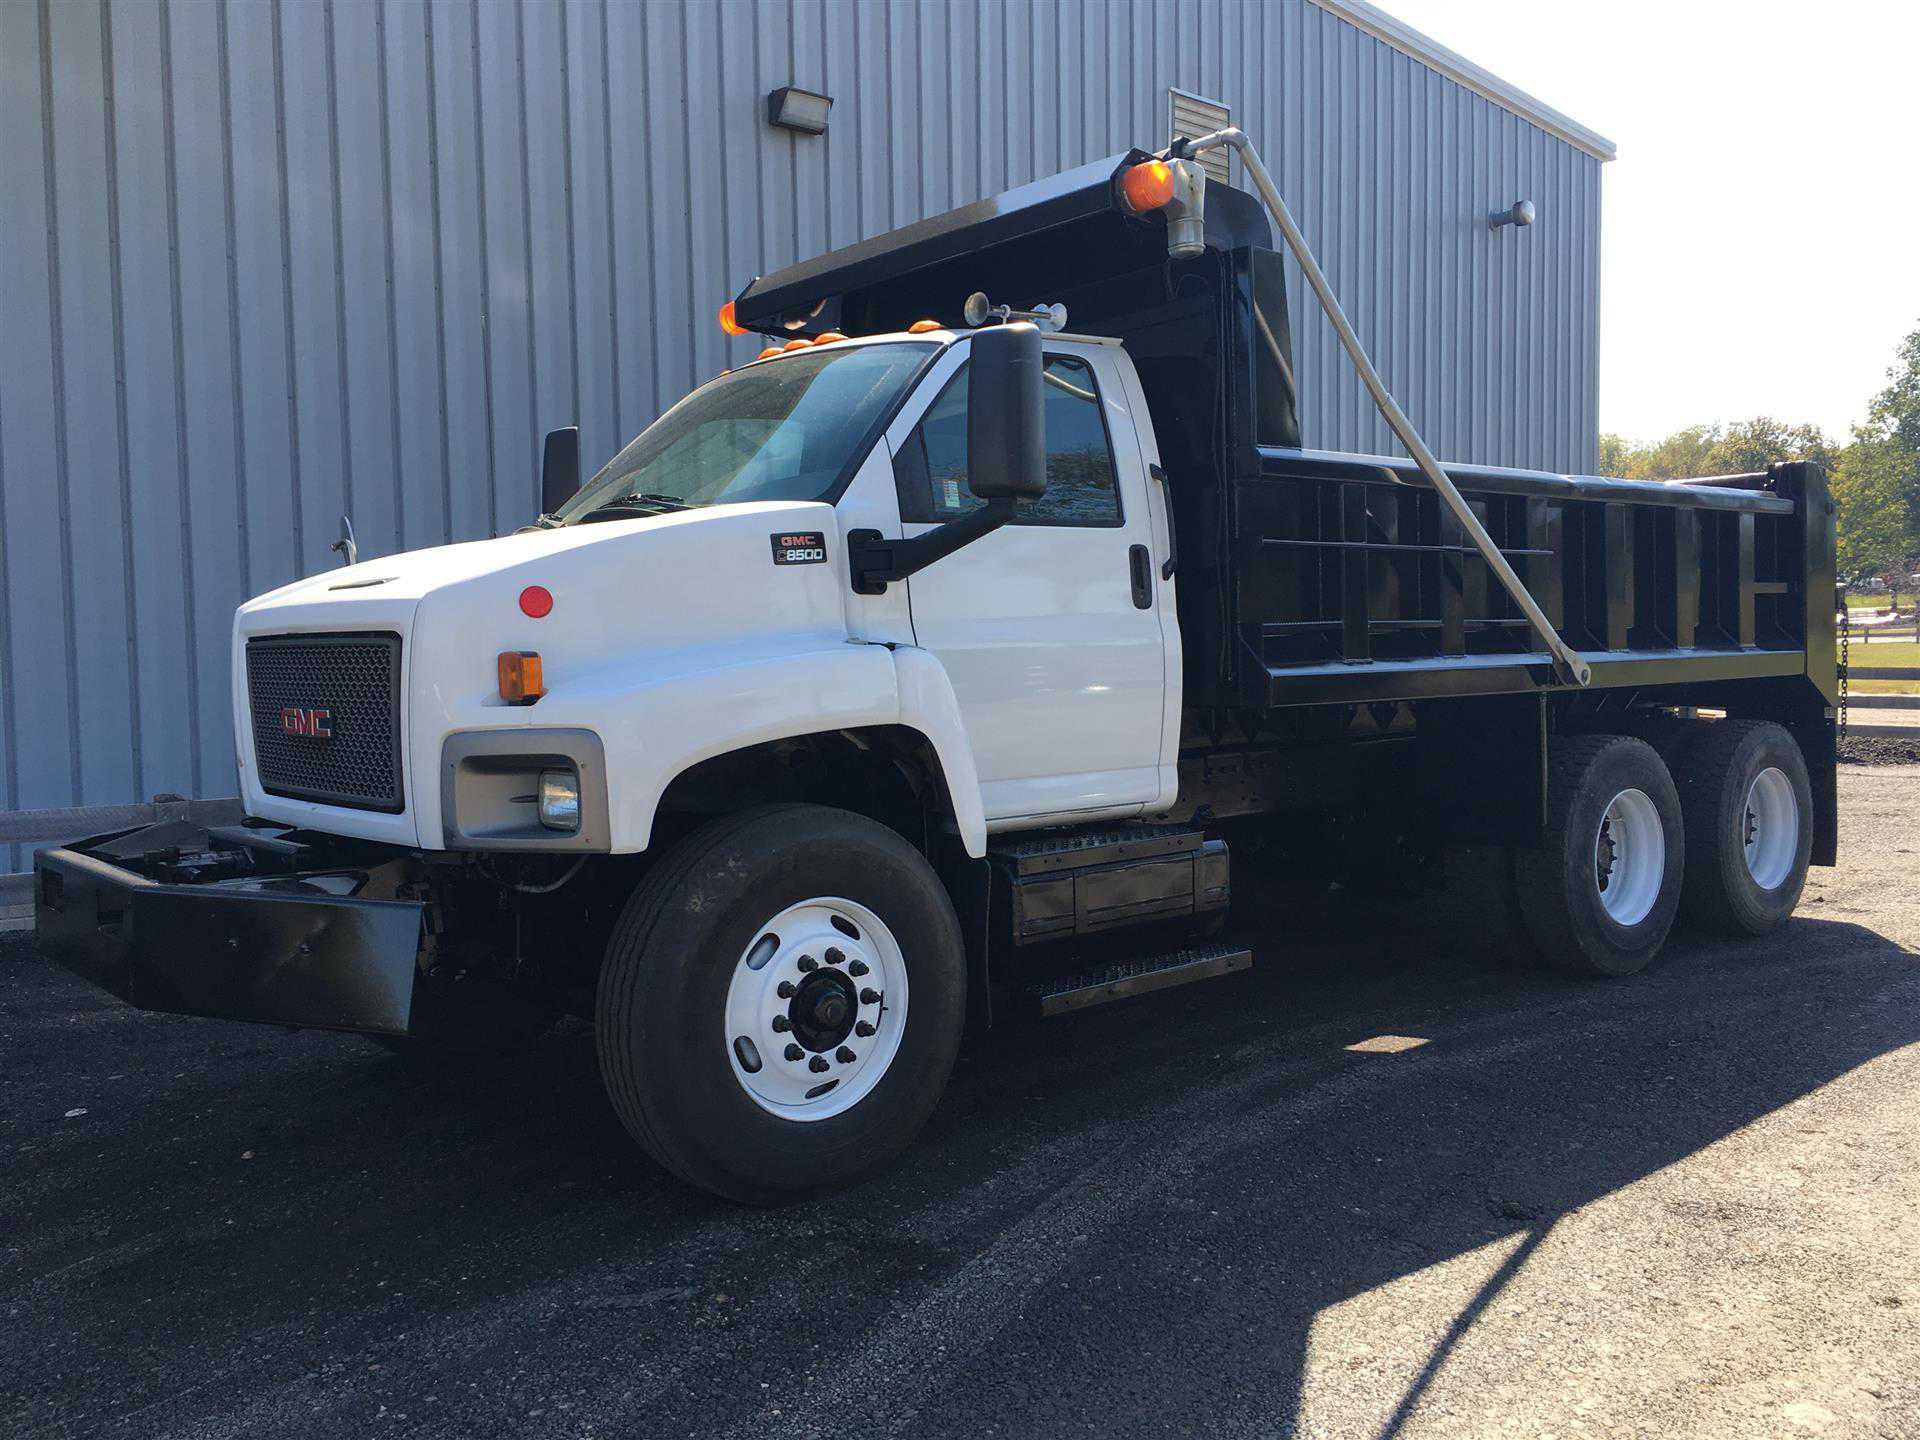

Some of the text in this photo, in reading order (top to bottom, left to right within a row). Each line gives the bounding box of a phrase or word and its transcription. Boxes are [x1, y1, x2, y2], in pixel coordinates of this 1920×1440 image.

[781, 536, 816, 546] GMC
[776, 549, 823, 561] C8500
[281, 707, 330, 737] GMC
